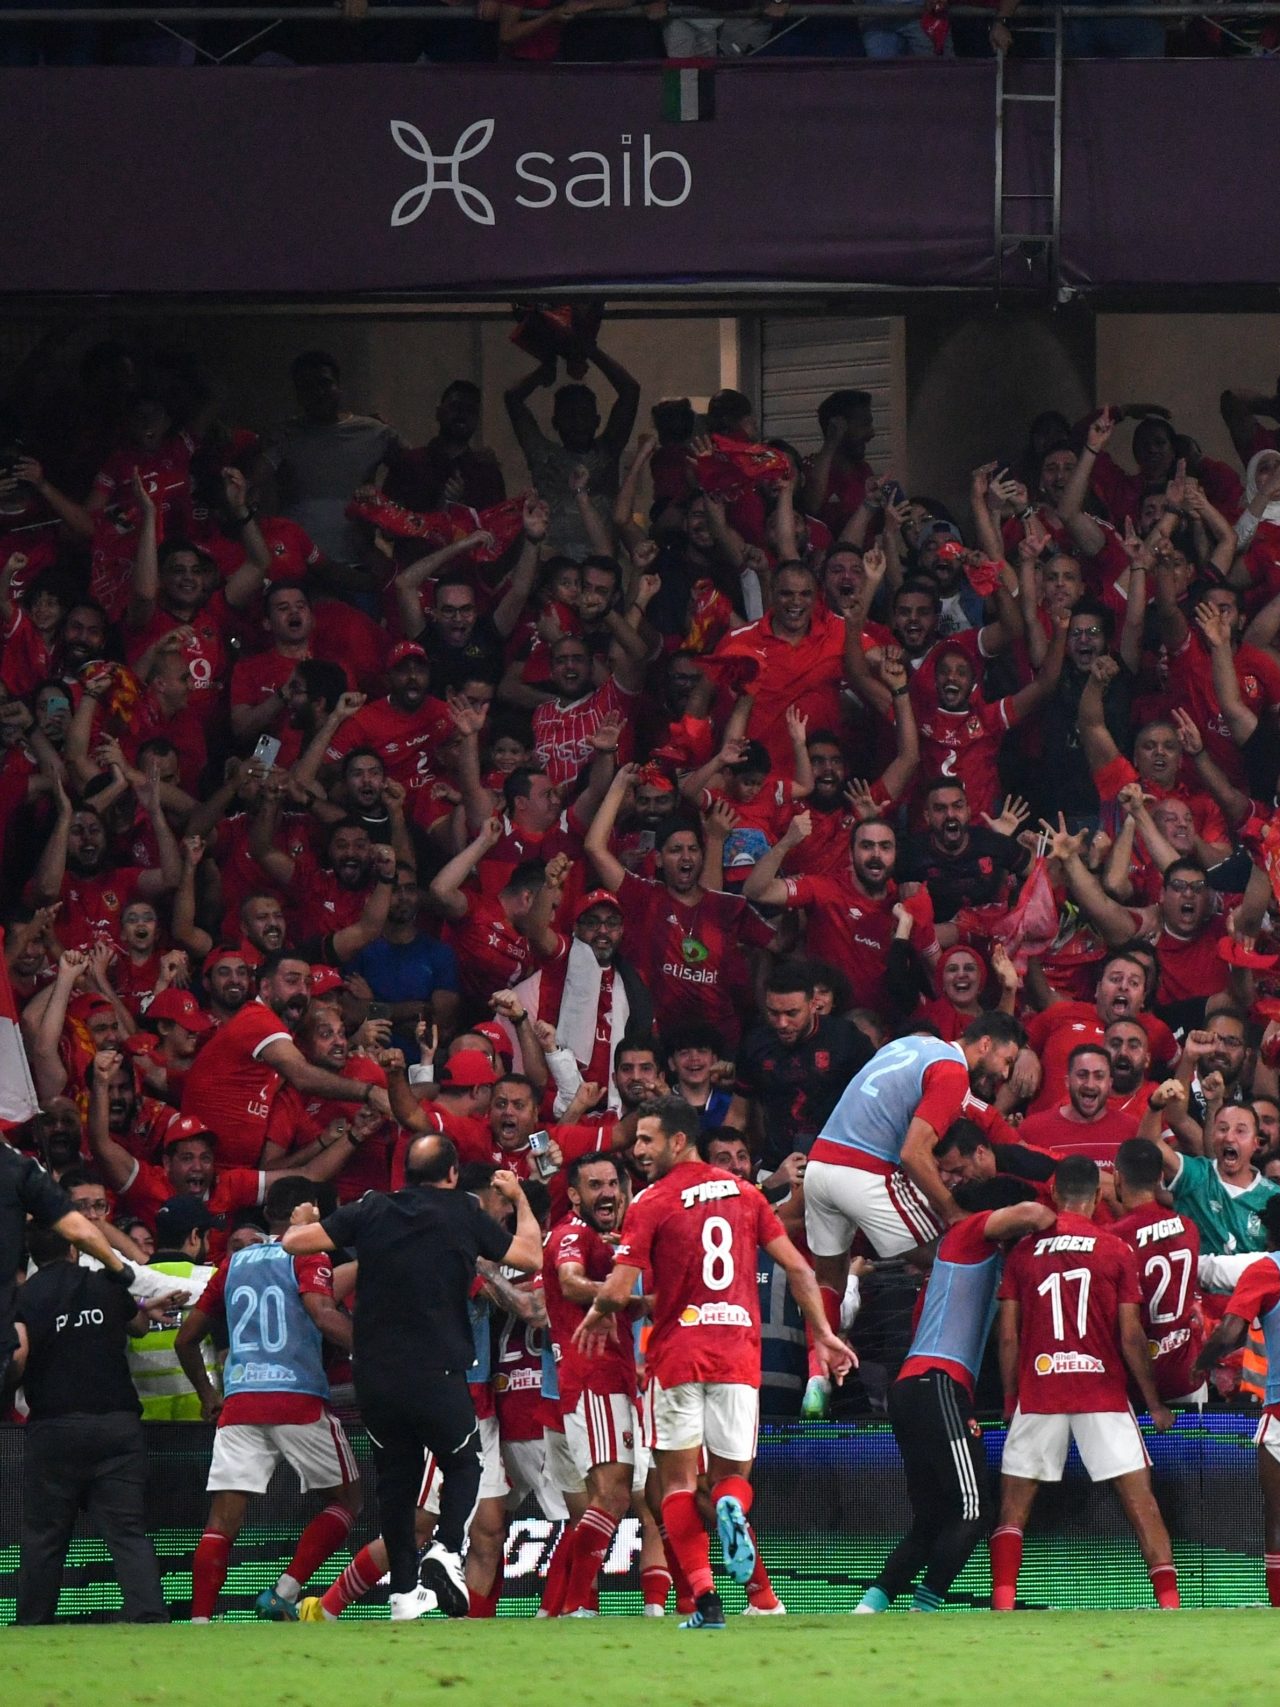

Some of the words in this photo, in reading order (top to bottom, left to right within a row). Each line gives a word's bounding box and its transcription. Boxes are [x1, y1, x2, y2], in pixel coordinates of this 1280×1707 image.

[514, 133, 692, 208] saib
[662, 962, 720, 984] etisalat
[702, 1216, 735, 1291] 8
[1033, 1234, 1097, 1256] TIGER
[1136, 1215, 1186, 1248] TIGER
[1037, 1267, 1092, 1341] 17
[1145, 1248, 1192, 1324] 27
[231, 1285, 288, 1353] 20
[512, 1376, 543, 1389] HELI
[1056, 1360, 1104, 1372] HELIX
